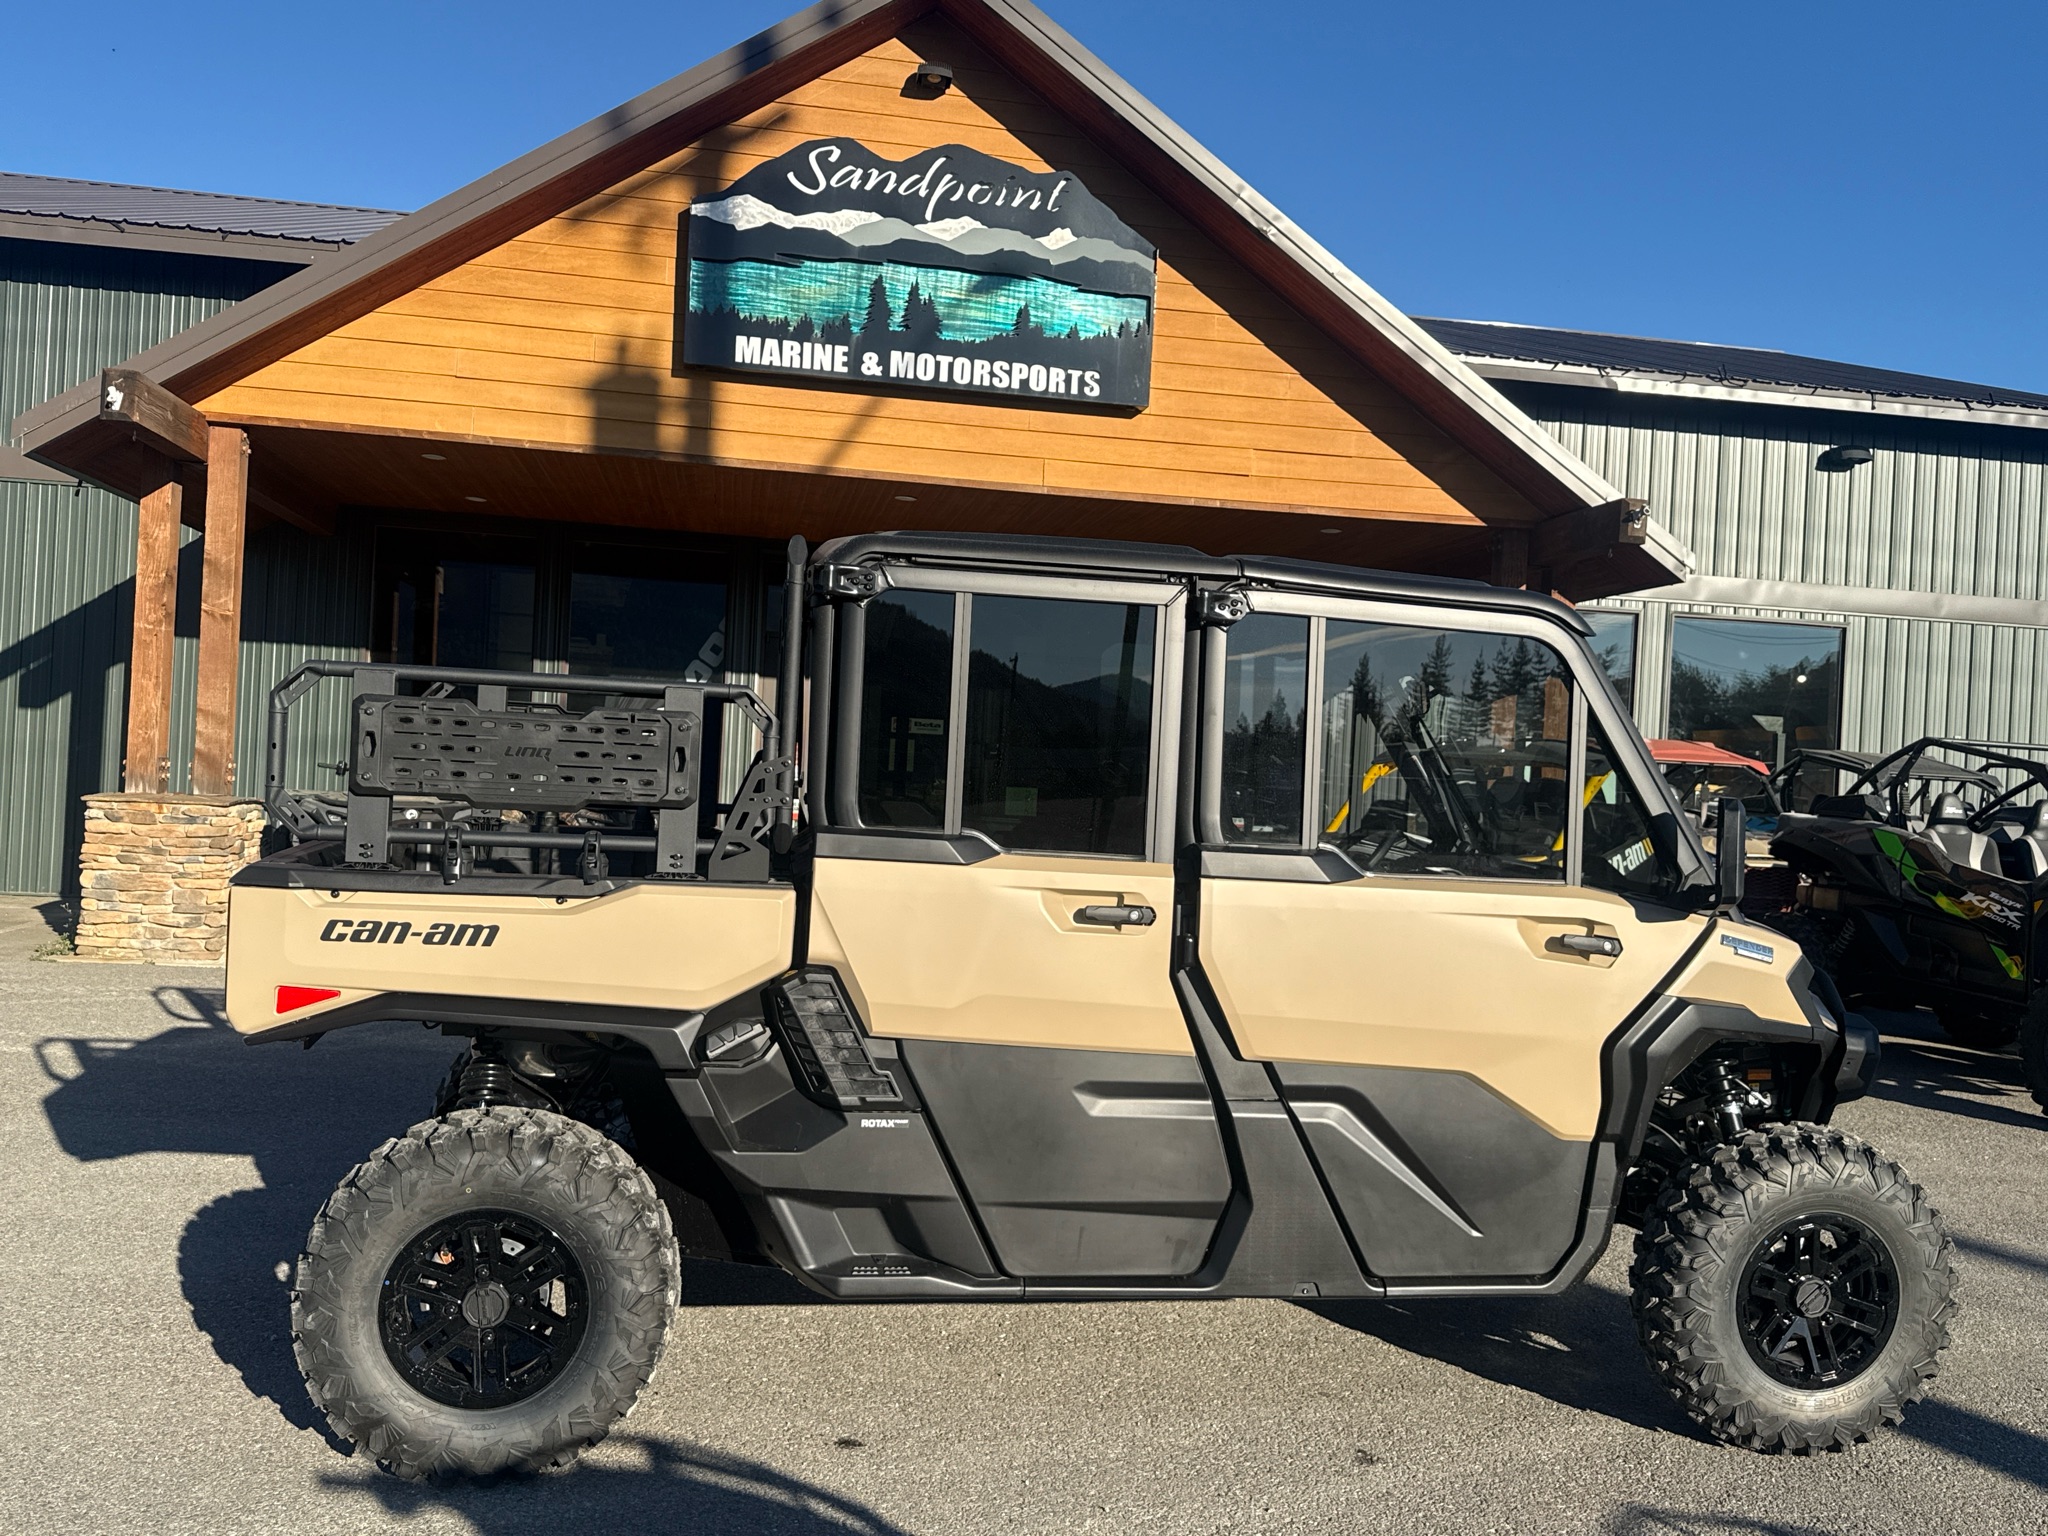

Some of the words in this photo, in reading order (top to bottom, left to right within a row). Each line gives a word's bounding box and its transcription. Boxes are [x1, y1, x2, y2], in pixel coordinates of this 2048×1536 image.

[786, 144, 1070, 221] Sandpoint
[734, 335, 849, 373] MARINE
[860, 350, 883, 377] &
[890, 350, 1101, 397] MOTORSPORTS
[1608, 841, 1647, 876] n-am
[1960, 891, 2025, 924] KRX
[320, 919, 500, 947] can-am
[1721, 935, 1773, 957] DEFENDER
[861, 1118, 895, 1128] ROTAX
